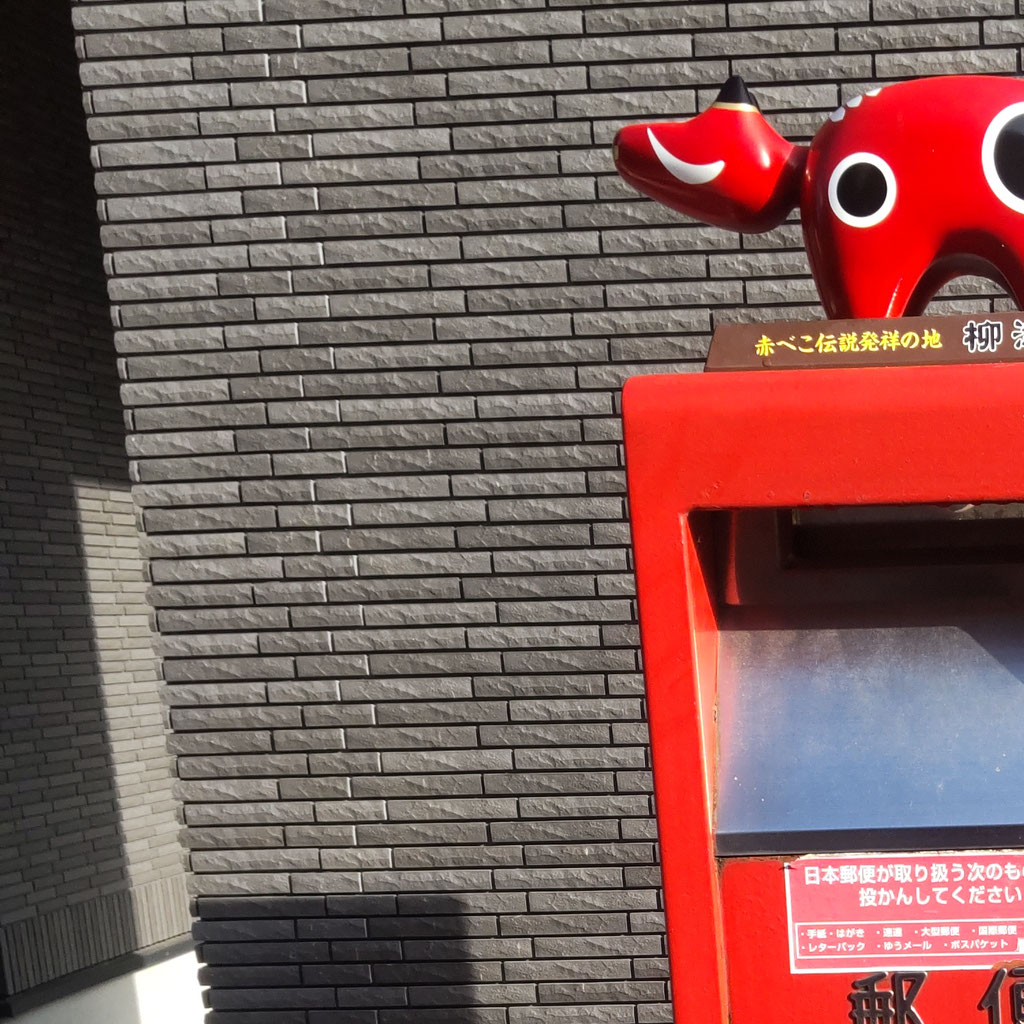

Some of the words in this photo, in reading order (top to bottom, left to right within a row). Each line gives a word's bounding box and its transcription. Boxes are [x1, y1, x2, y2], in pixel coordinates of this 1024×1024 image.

[755, 328, 943, 357] 赤べこ伝説発祥の地
[859, 886, 1022, 908] 投かんしてください
